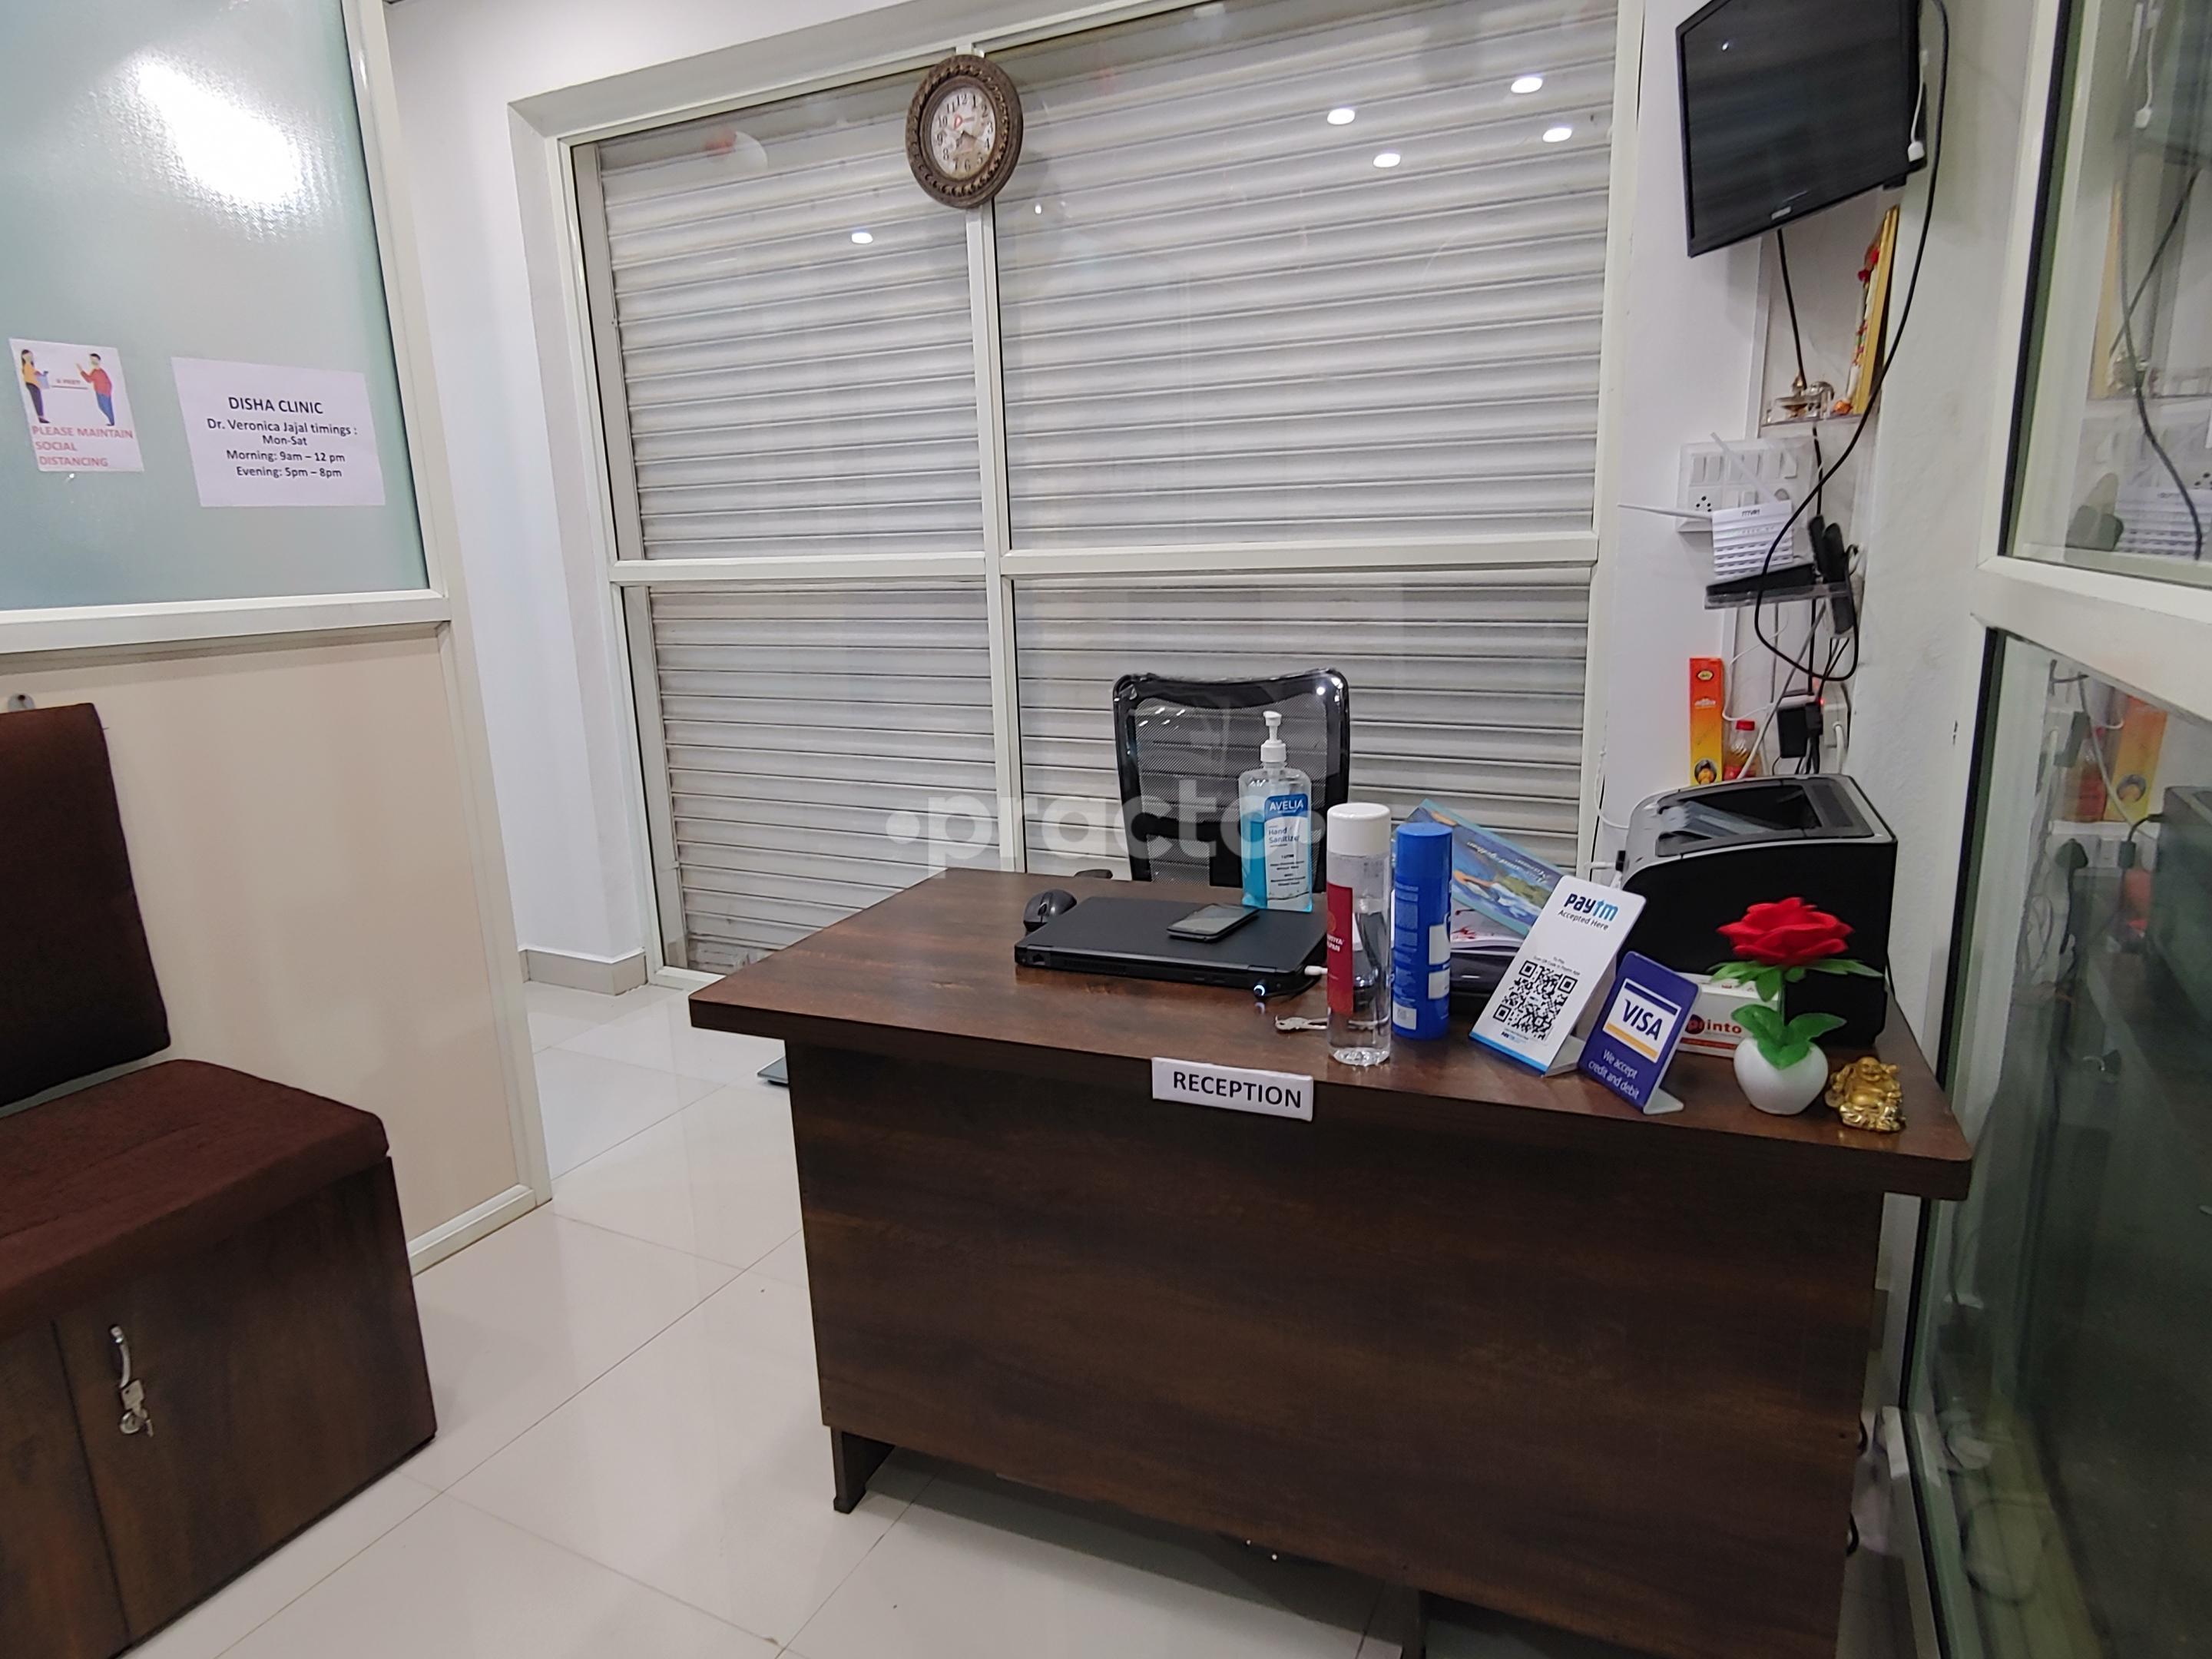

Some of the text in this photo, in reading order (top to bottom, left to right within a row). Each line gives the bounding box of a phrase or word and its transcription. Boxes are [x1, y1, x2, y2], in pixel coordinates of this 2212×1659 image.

[957, 94, 968, 106] 12
[947, 101, 955, 114] 11
[939, 115, 948, 128] 10
[942, 147, 949, 161] 8
[228, 396, 323, 414] DISHA CLINIC
[31, 426, 133, 439] PLEASE MAINTAIN
[207, 418, 225, 429] Dr.
[227, 419, 280, 432] Veronica
[283, 422, 308, 435] Jajal
[35, 441, 78, 452] SOCIAL
[262, 435, 308, 445] Mon-Sat
[39, 455, 108, 467] DISTANCING
[227, 449, 277, 462] Morning:
[280, 451, 303, 461] 9am
[314, 452, 326, 462] 12
[329, 453, 346, 464] pm
[237, 465, 283, 478] Evening:
[285, 467, 308, 478] 5pm
[320, 468, 343, 479] 8pm
[1269, 799, 1304, 812] AVELIA
[1268, 826, 1287, 836] Hand
[1558, 909, 1609, 930] Accepted Here
[1623, 998, 1663, 1041] VISA
[1603, 1048, 1638, 1079] We accept
[1588, 1061, 1640, 1101] credit and debit
[1173, 1071, 1301, 1108] RECEPTION
